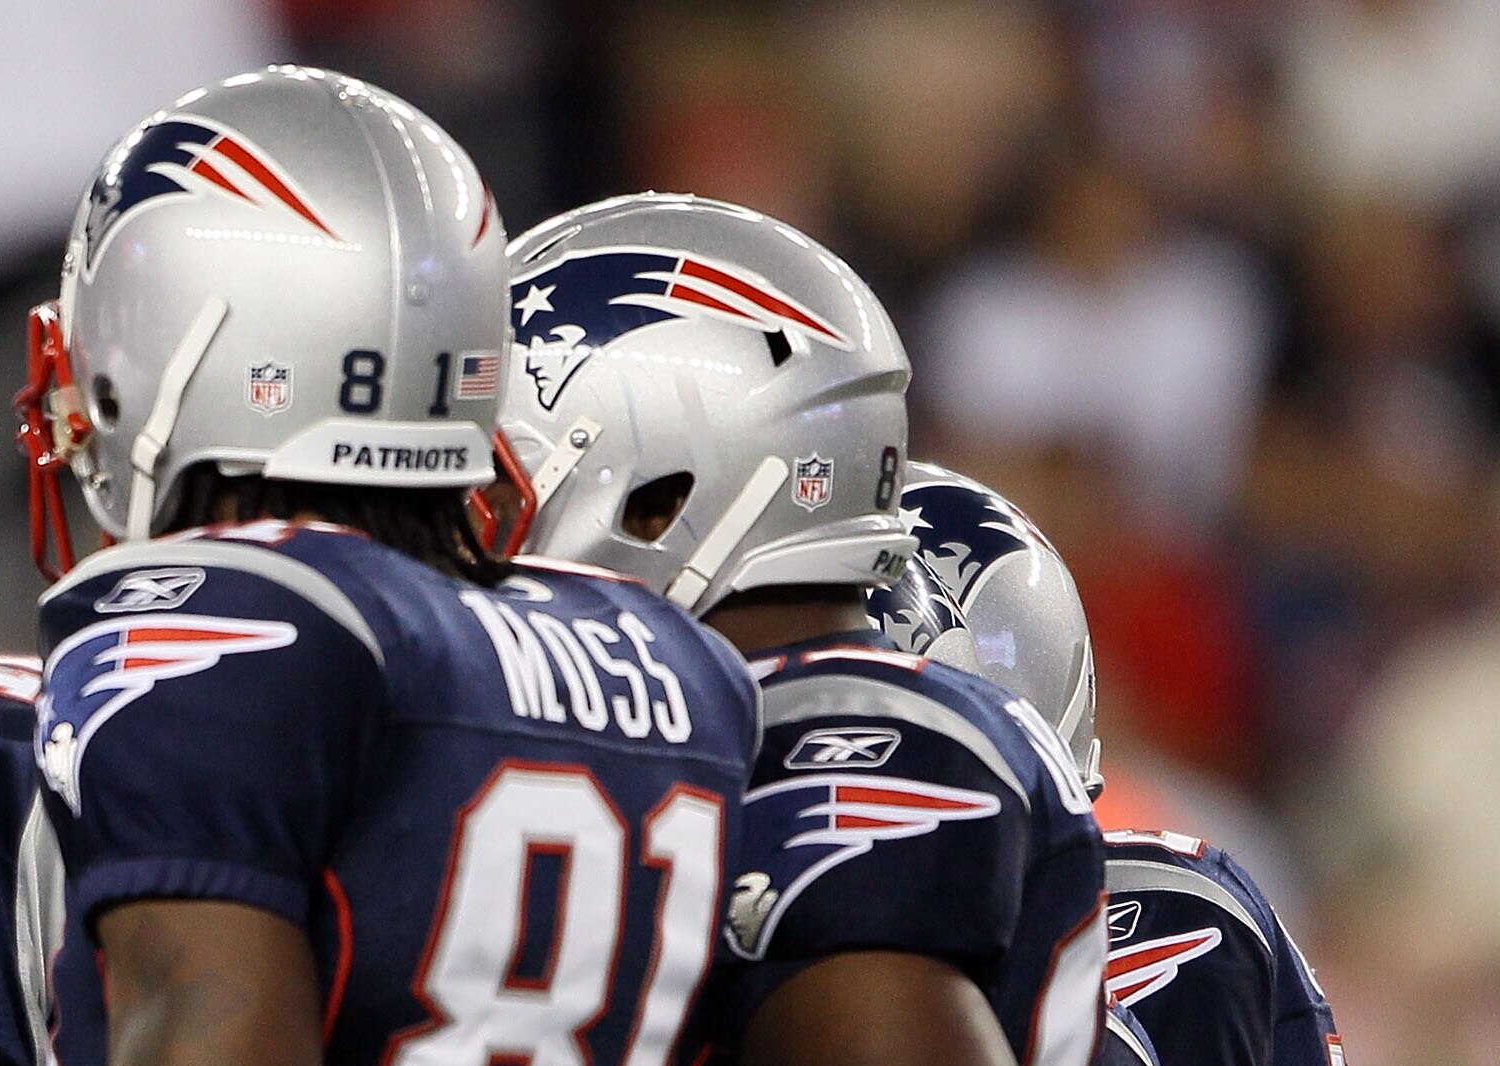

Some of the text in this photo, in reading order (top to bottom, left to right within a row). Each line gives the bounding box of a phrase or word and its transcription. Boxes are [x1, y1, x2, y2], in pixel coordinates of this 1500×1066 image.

[332, 443, 469, 473] PATRIOTS
[798, 479, 828, 502] NFL
[458, 575, 693, 744] MOSS
